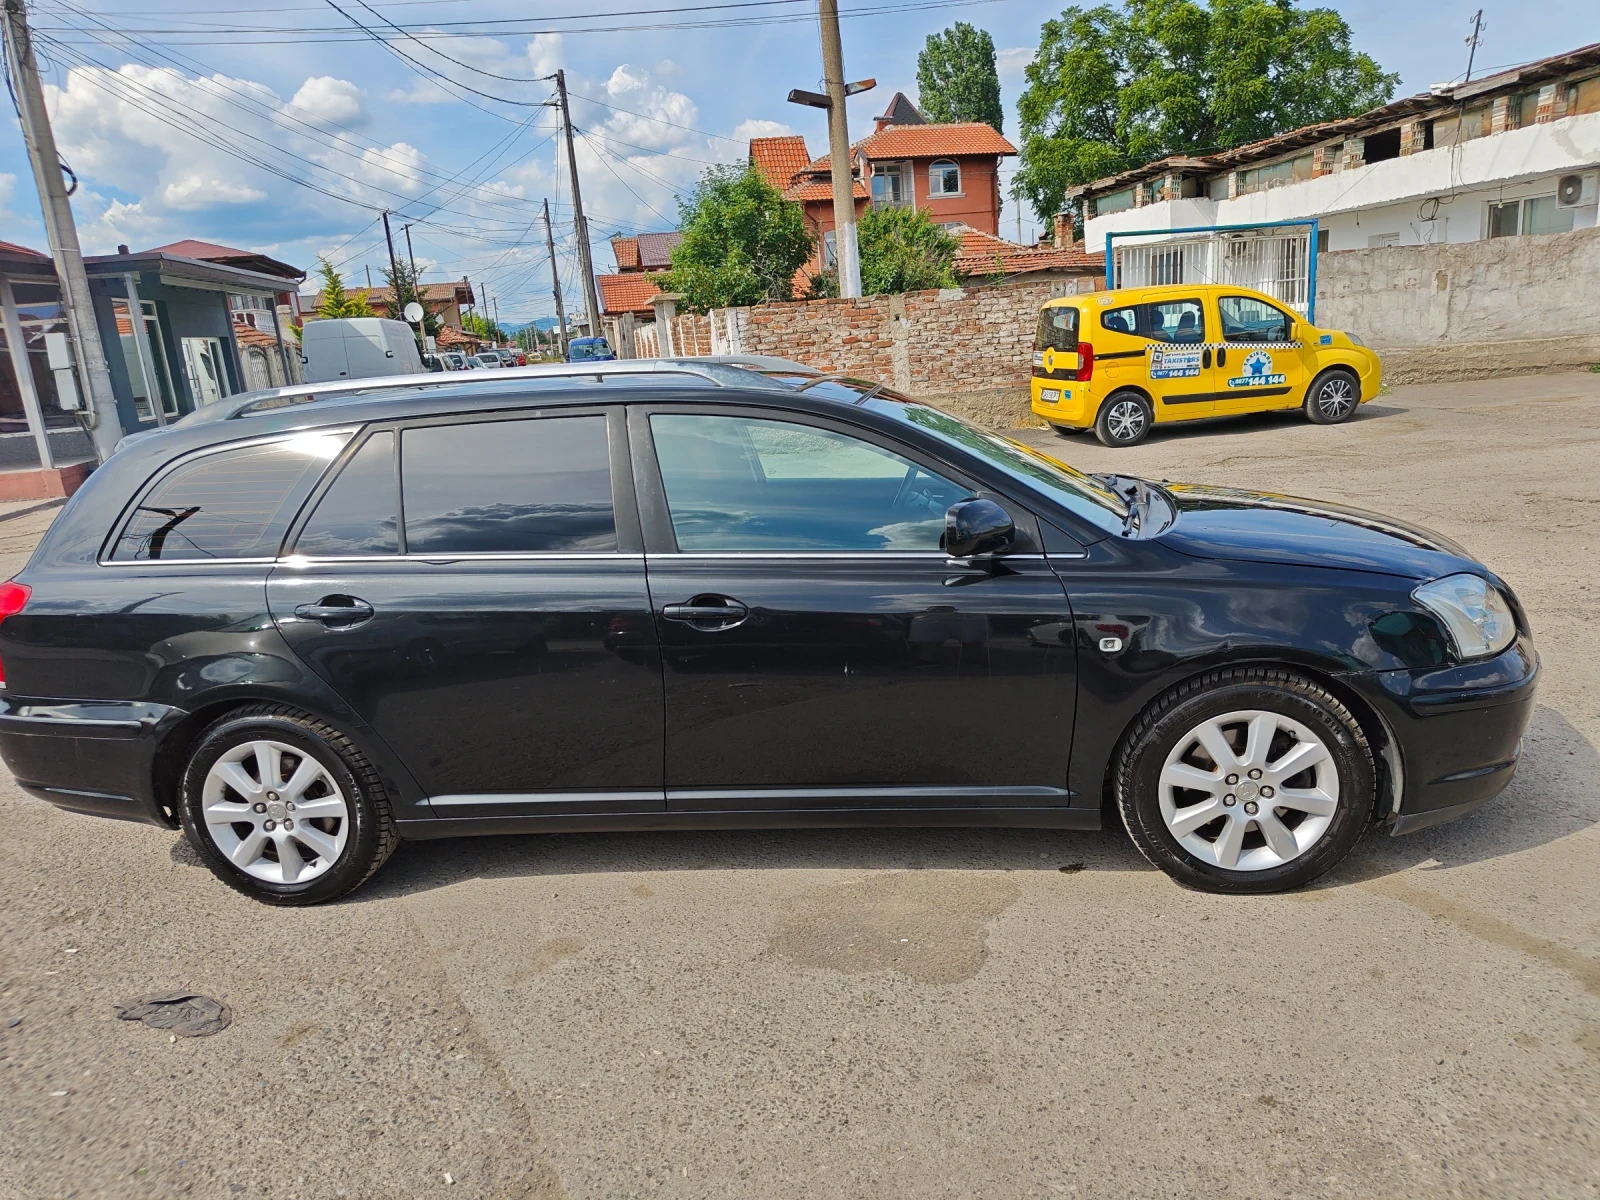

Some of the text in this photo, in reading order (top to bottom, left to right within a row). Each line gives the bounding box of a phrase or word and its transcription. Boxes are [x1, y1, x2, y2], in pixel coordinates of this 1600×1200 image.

[1243, 351, 1273, 366] TAXISTARS
[1169, 369, 1184, 377] 144
[1185, 368, 1200, 376] 144
[1249, 376, 1266, 386] 144
[1268, 375, 1285, 384] 144
